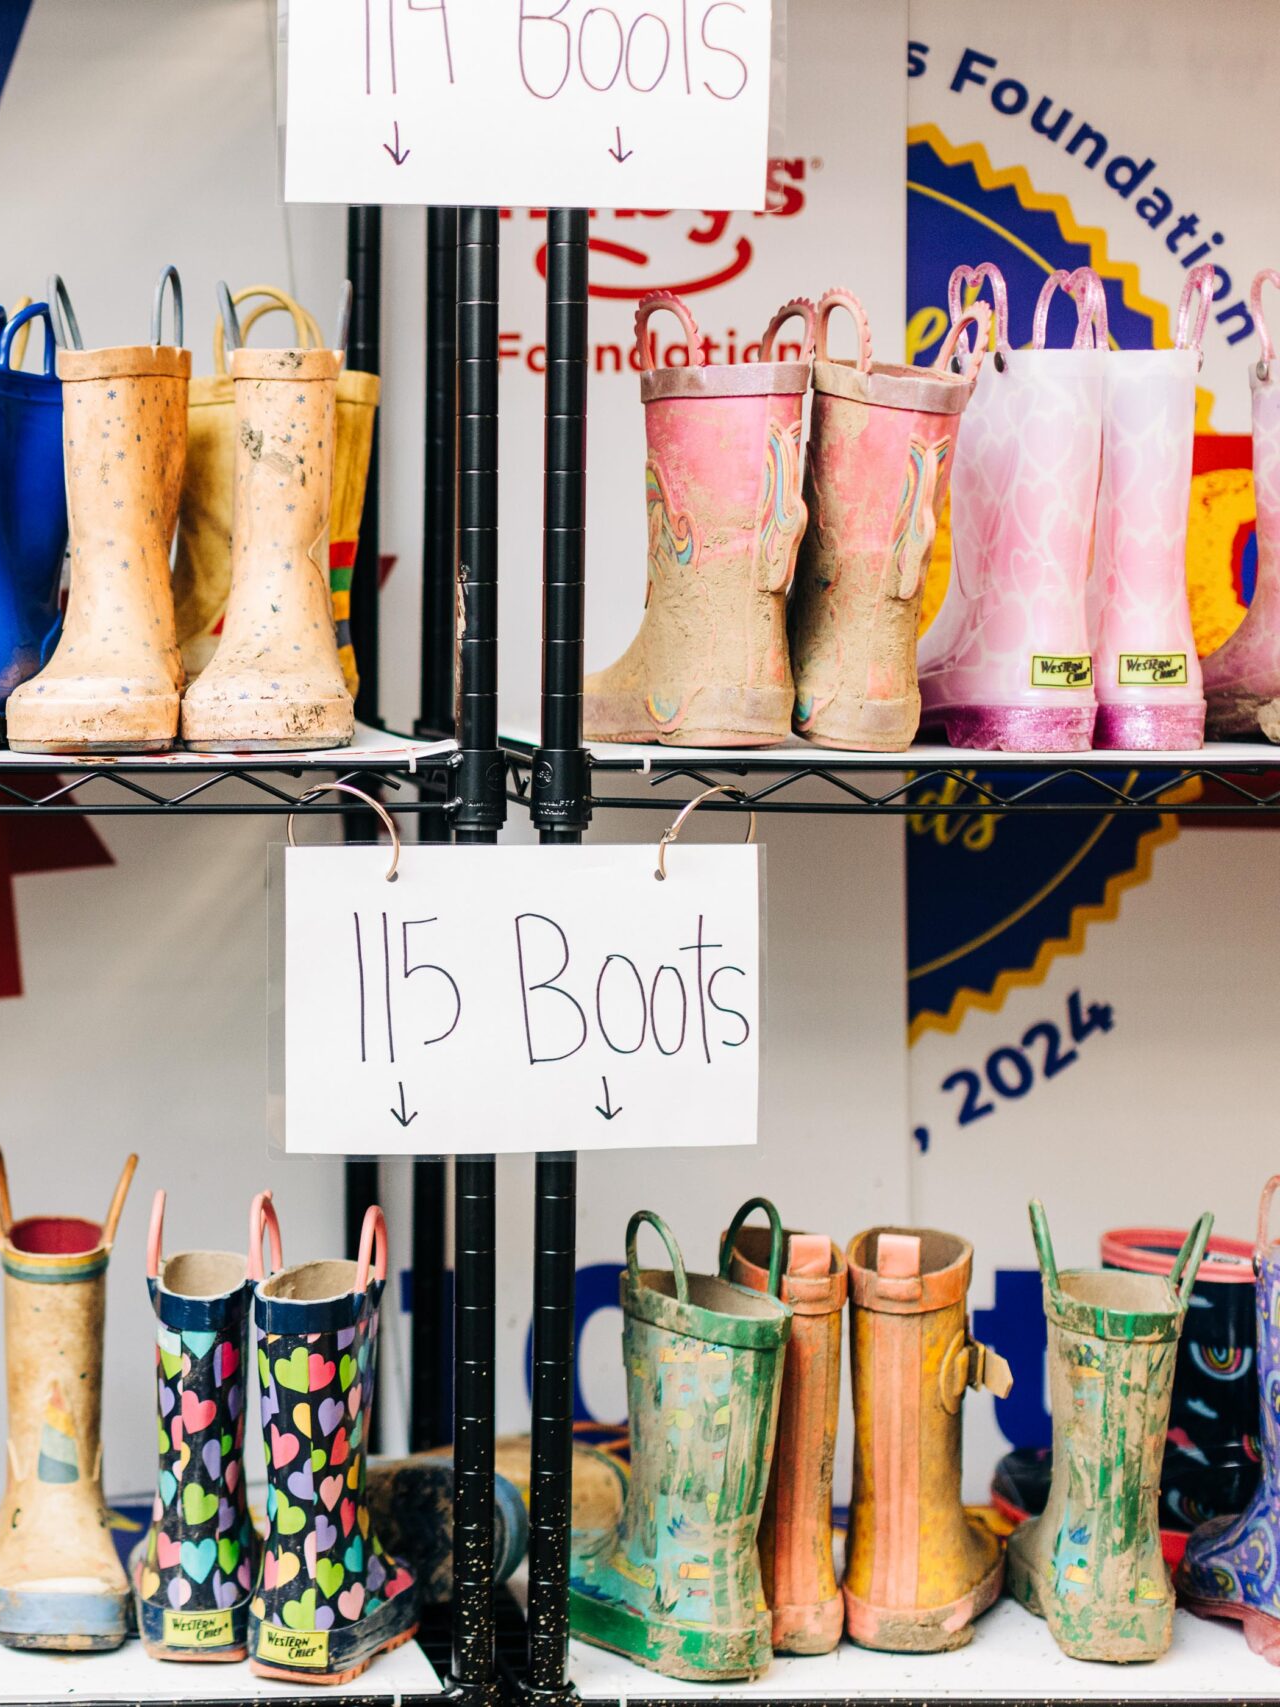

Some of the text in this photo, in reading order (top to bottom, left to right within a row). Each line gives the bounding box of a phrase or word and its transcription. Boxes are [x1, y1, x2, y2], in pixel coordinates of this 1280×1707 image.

[354, 911, 750, 1065] 115 Boots
[941, 989, 1115, 1127] 2024
